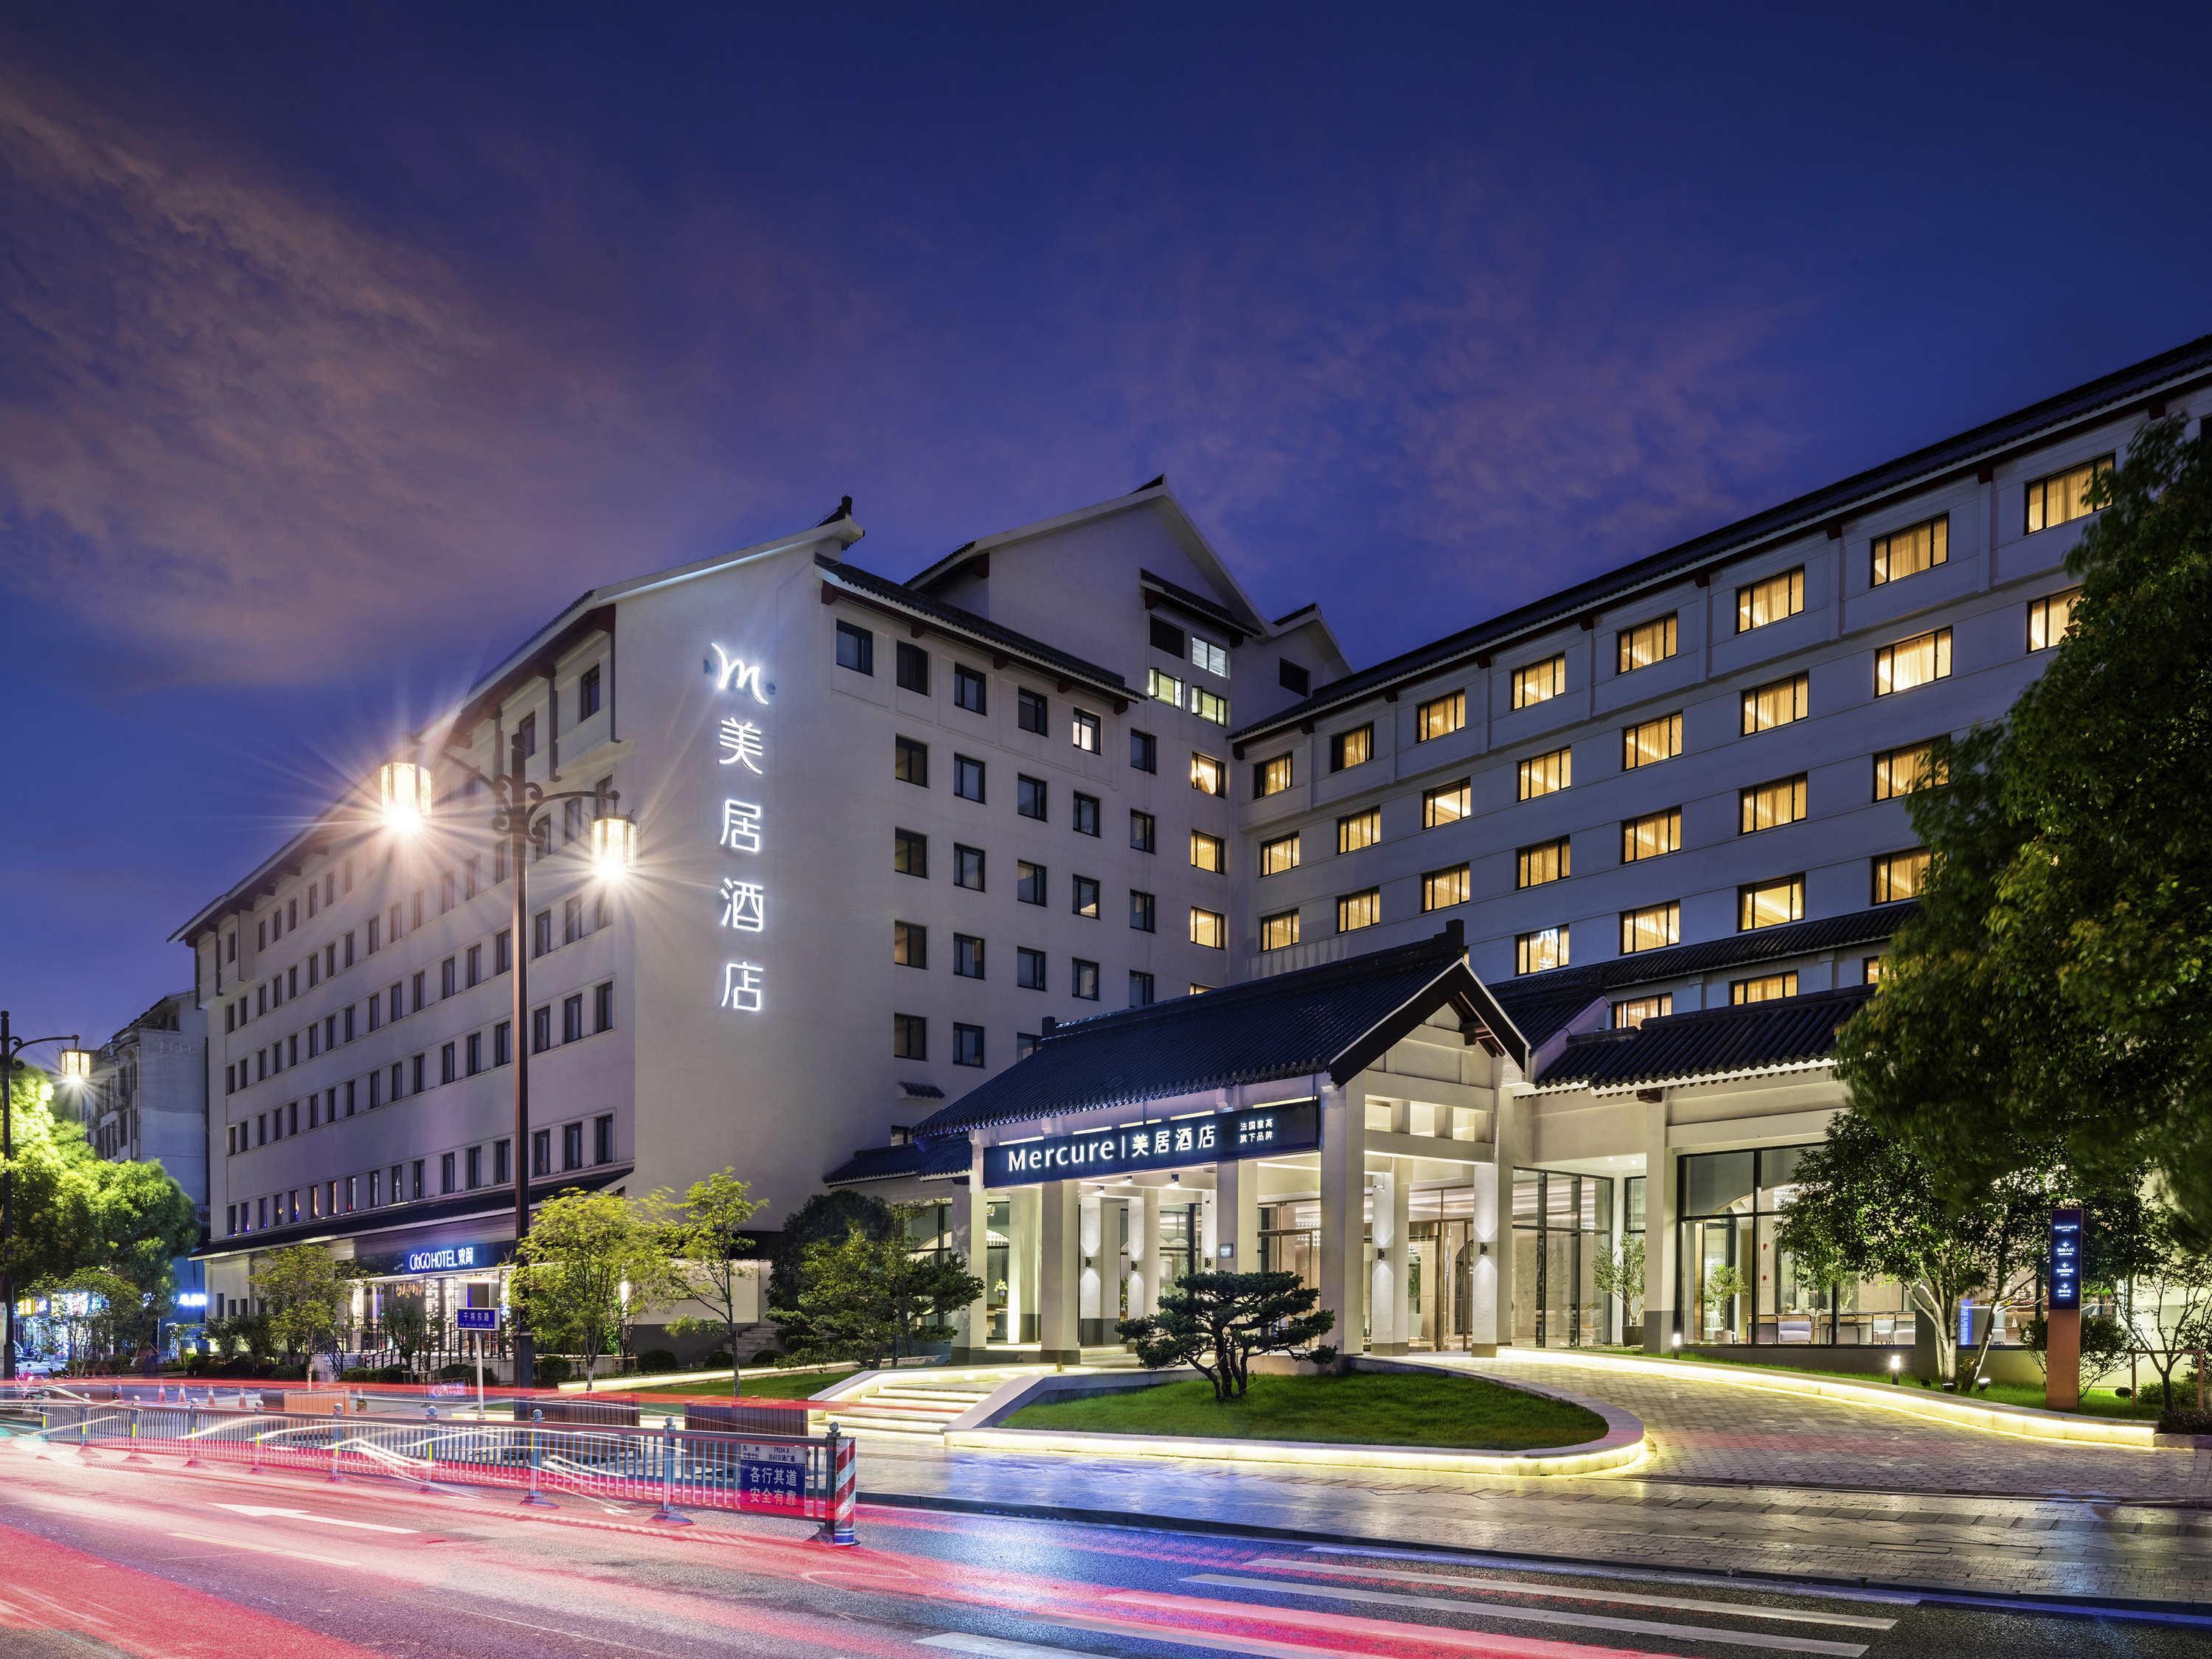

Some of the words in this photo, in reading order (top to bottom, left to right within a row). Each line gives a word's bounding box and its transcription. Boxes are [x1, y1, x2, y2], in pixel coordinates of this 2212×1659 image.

[718, 717, 764, 1012] 美居酒店
[1008, 1139, 1115, 1172] Mercure
[1133, 1125, 1216, 1158] 美居酒店
[431, 1250, 458, 1268] HOTEL
[750, 1466, 797, 1486] 各行其道
